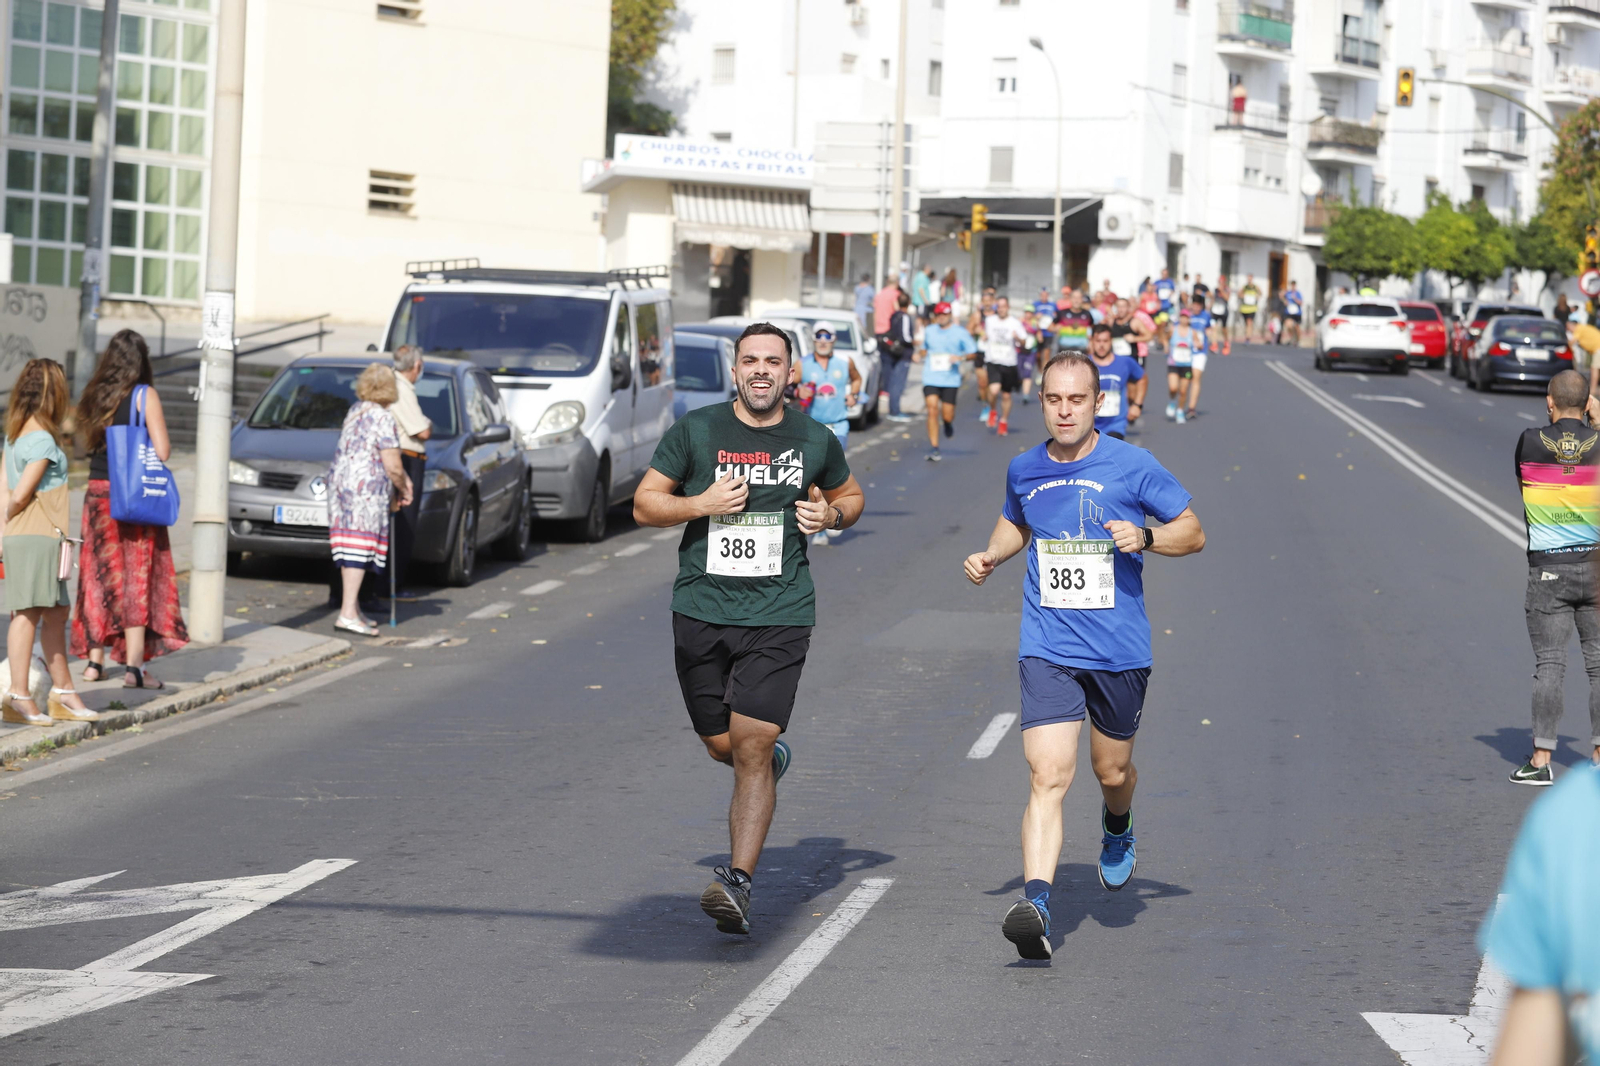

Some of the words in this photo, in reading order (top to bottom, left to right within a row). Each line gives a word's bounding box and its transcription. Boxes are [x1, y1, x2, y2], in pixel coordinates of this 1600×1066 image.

[640, 141, 721, 155] CHURROS
[663, 156, 740, 170] PATATAS
[747, 163, 806, 175] FRITAS
[717, 449, 771, 465] CrossFit
[714, 463, 804, 490] HUELVA
[1037, 479, 1067, 491] VUELTA
[1074, 478, 1105, 493] HUELVA
[286, 508, 318, 522] 9244
[722, 515, 746, 525] VUELTA
[747, 516, 753, 525] A
[753, 515, 779, 525] HUELVA
[720, 537, 756, 559] 388
[1049, 543, 1074, 553] VUELTA
[1075, 543, 1081, 553] A
[1082, 543, 1108, 553] HUELVA
[1050, 567, 1086, 590] 383
